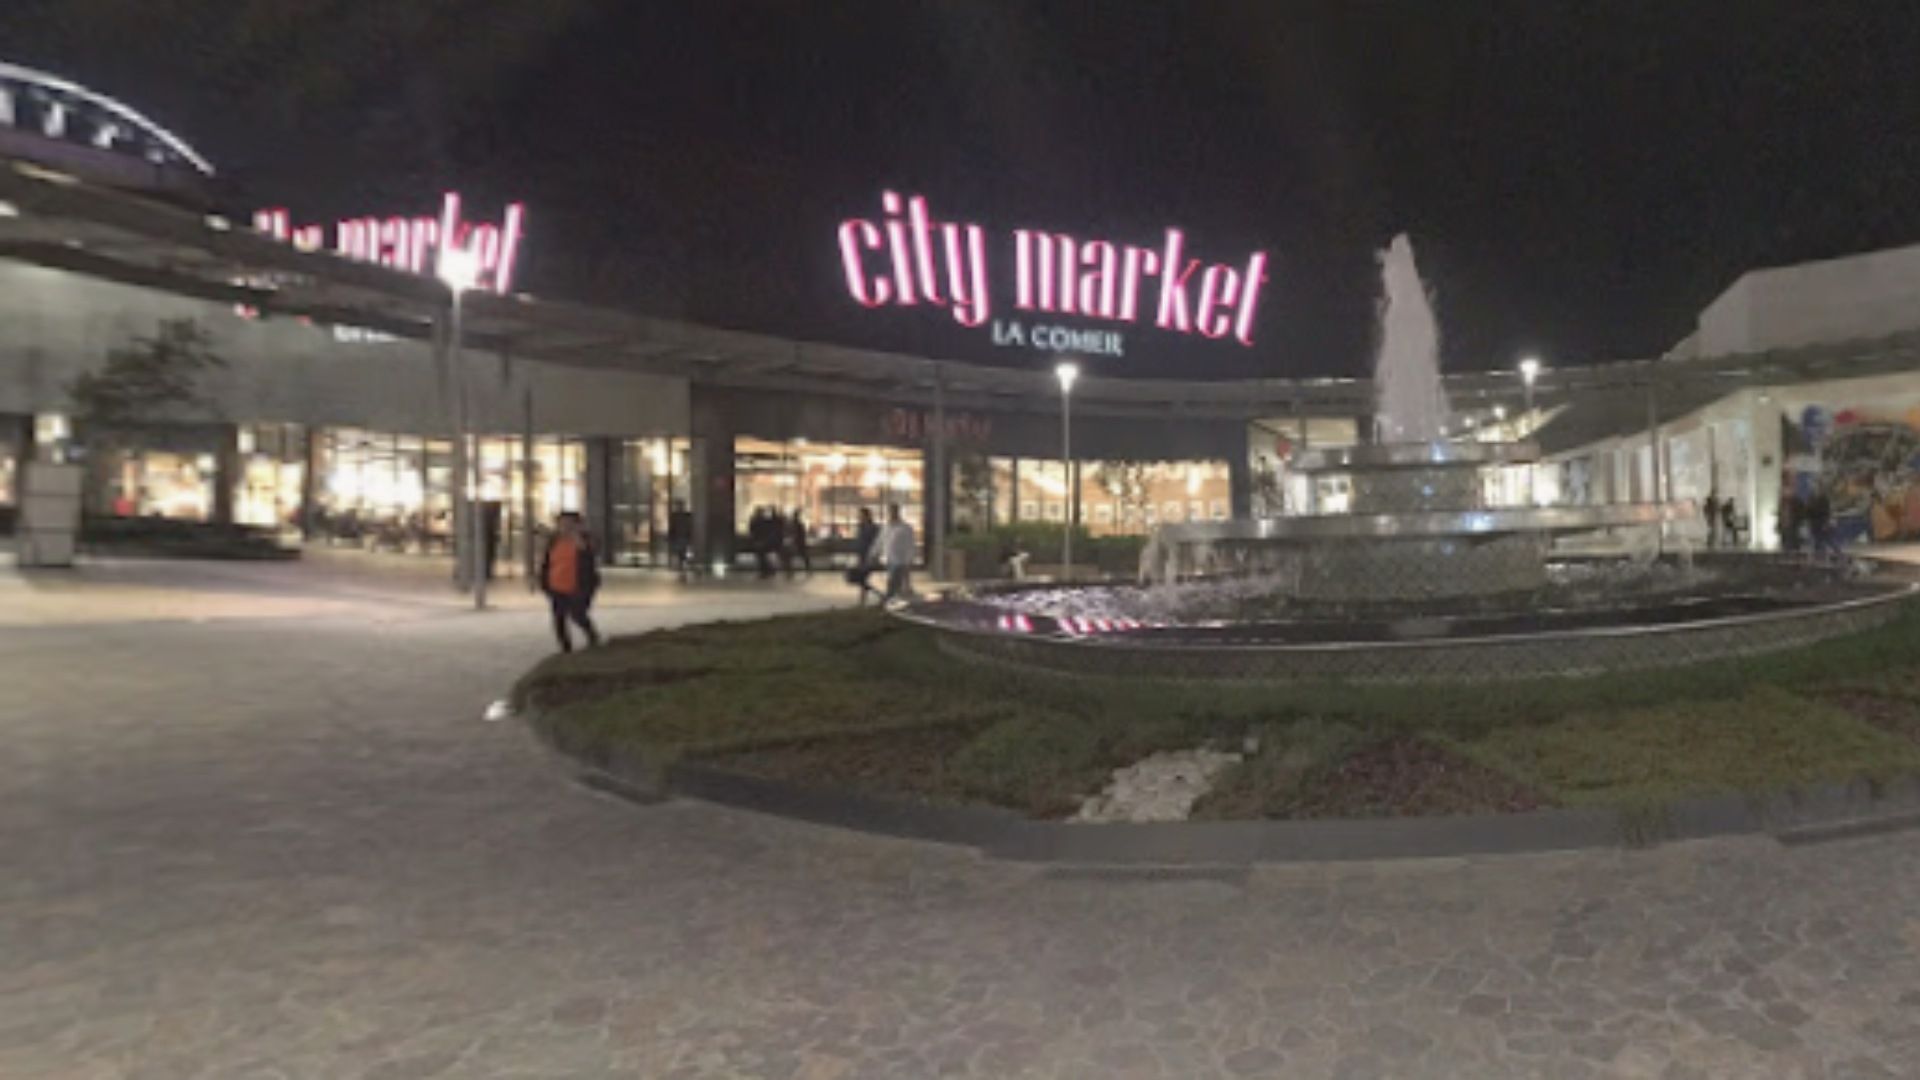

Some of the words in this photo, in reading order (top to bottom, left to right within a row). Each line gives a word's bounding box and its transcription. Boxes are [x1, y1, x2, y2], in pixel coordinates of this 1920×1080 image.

[838, 190, 989, 327] city
[1013, 227, 1269, 346] market
[992, 319, 1025, 346] LA
[1031, 323, 1125, 357] COMER
